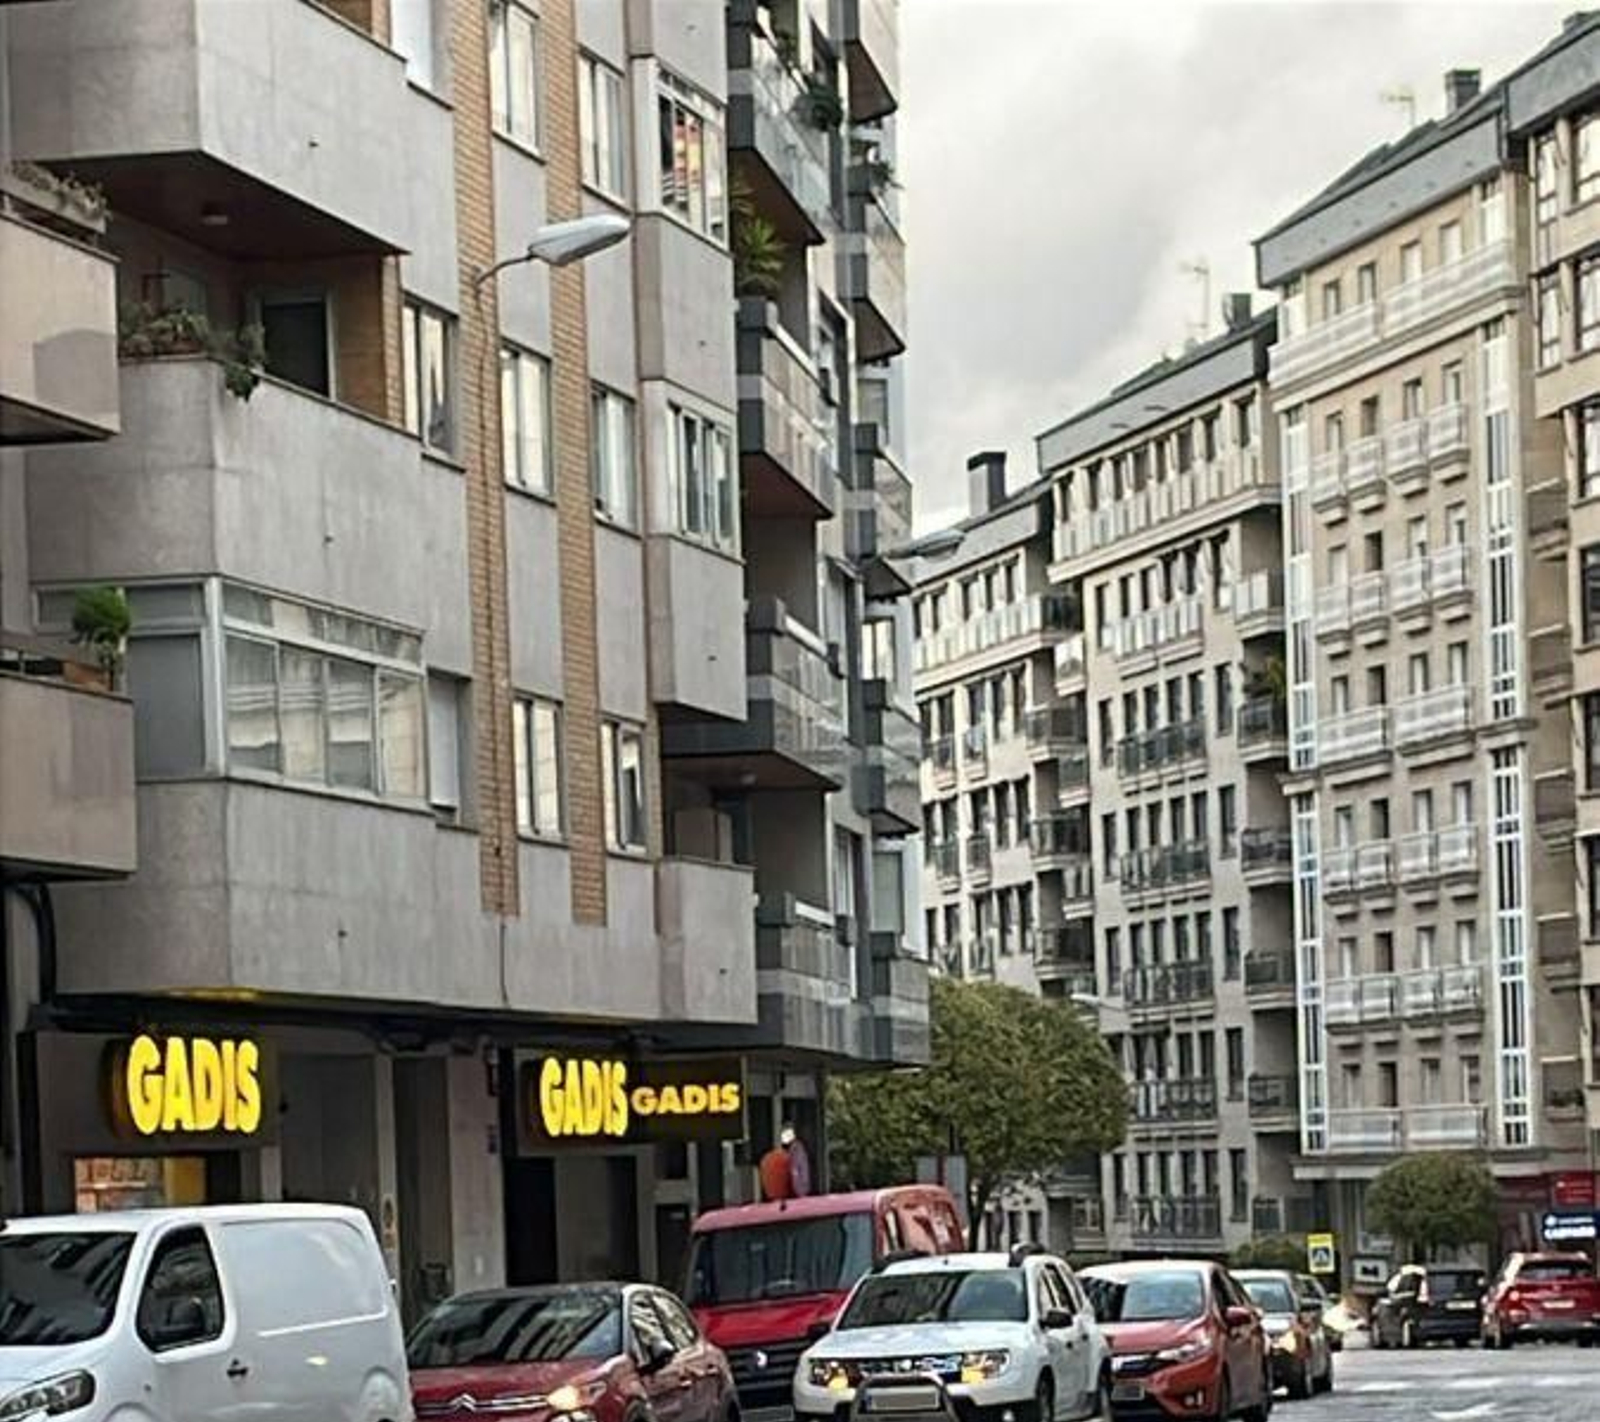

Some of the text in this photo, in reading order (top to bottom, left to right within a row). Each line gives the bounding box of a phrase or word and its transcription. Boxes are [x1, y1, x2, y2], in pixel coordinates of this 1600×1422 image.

[127, 1034, 261, 1135] GADIS
[539, 1057, 628, 1137] GADIS
[631, 1083, 741, 1116] GADIS
